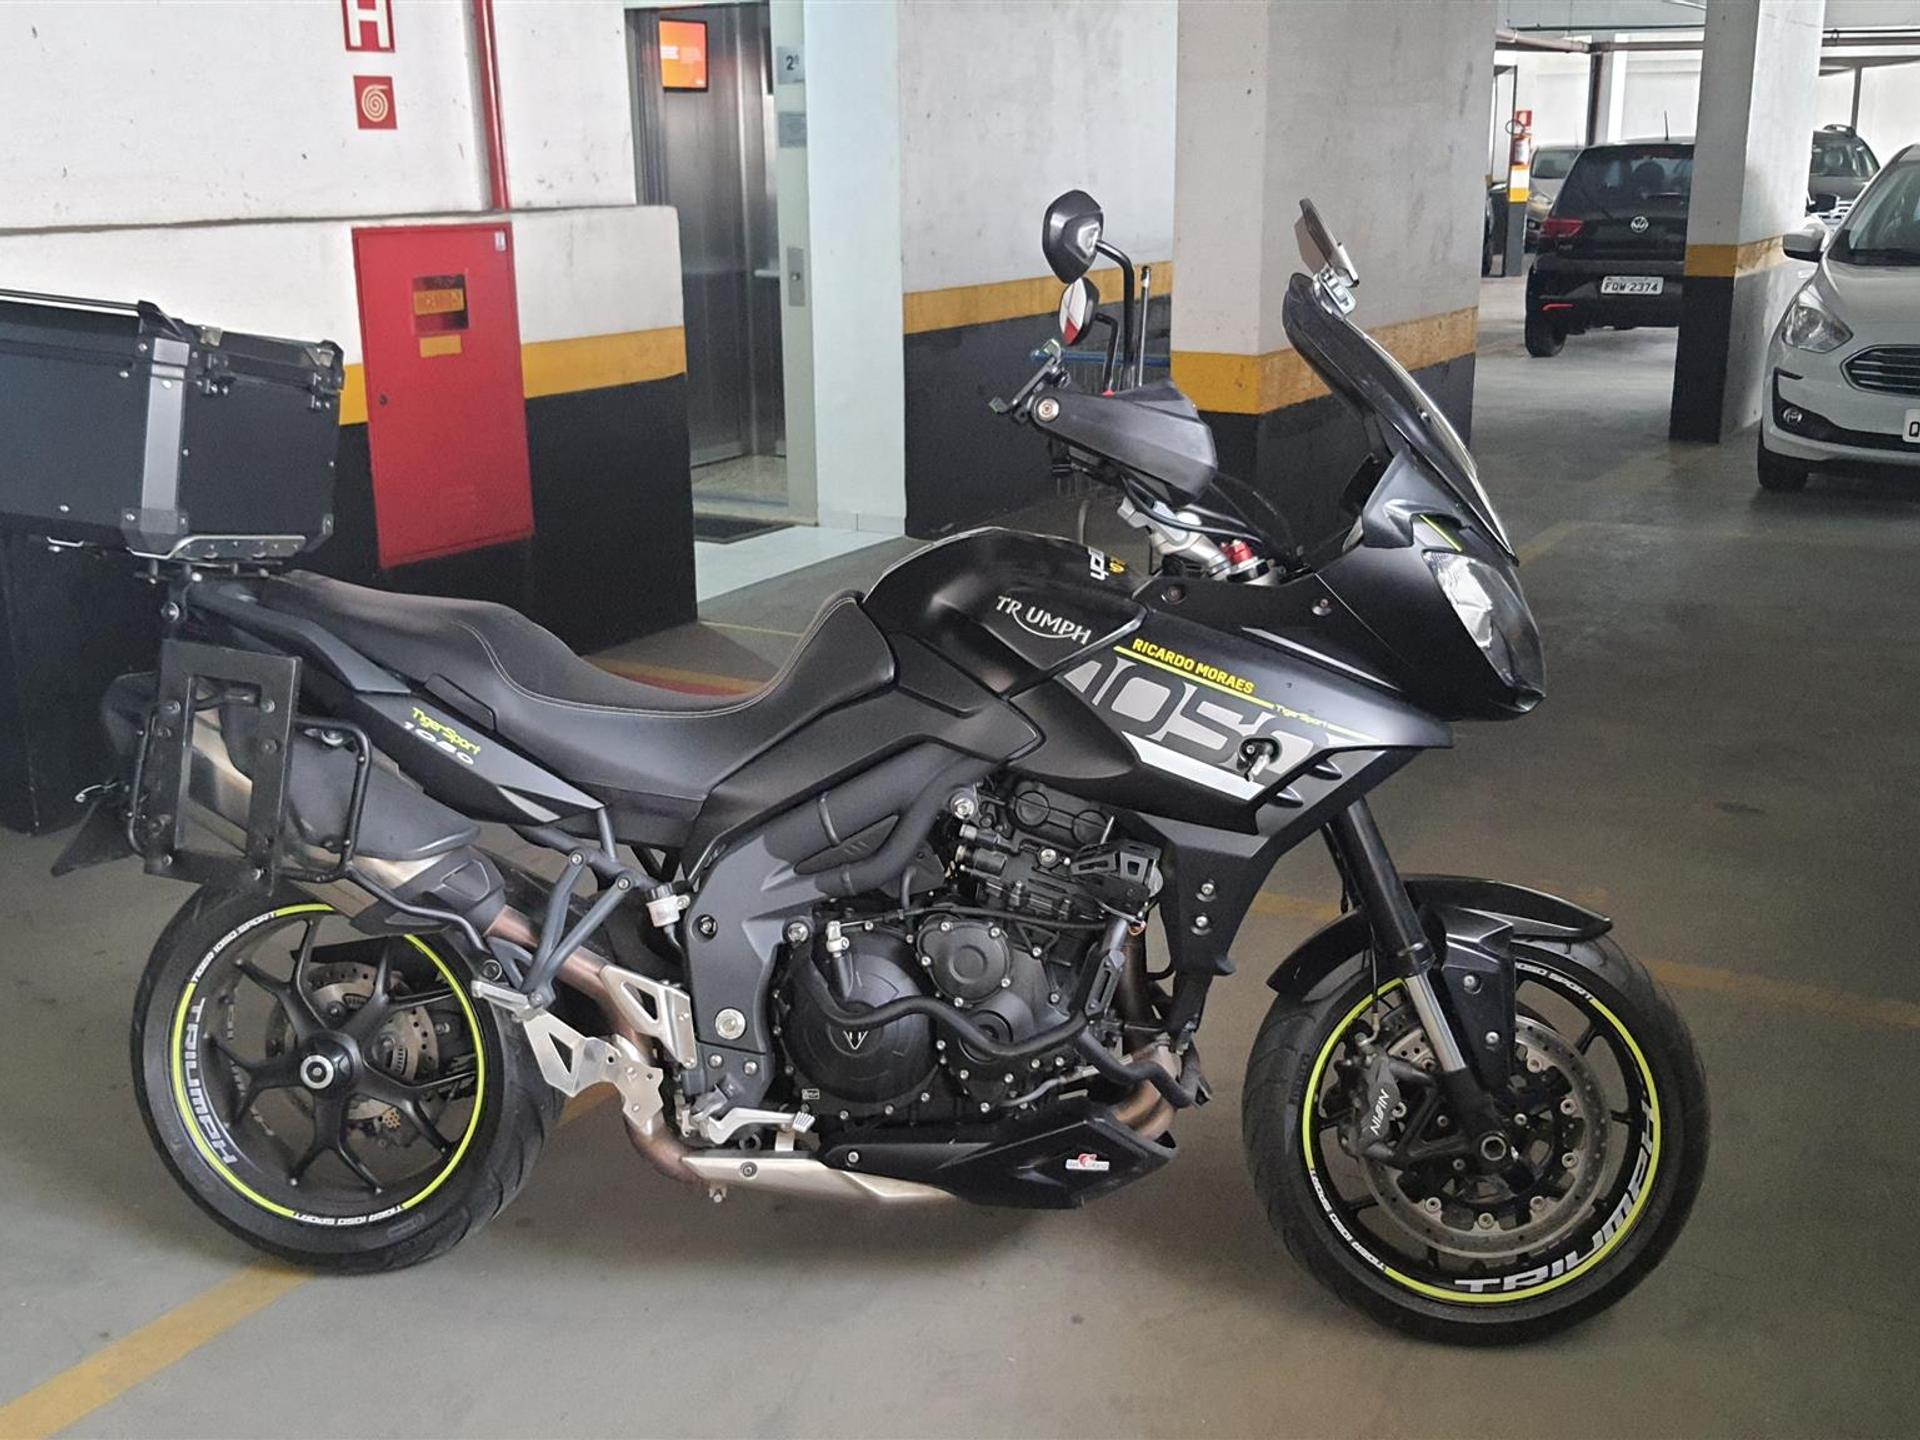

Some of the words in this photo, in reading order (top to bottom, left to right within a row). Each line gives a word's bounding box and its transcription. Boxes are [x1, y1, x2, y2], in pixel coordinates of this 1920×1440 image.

[344, 0, 390, 48] H
[995, 595, 1092, 645] TRUMPH
[1132, 638, 1195, 670] RICARDO
[1195, 662, 1256, 695] MORAES
[184, 997, 238, 1164] TRIUMPH
